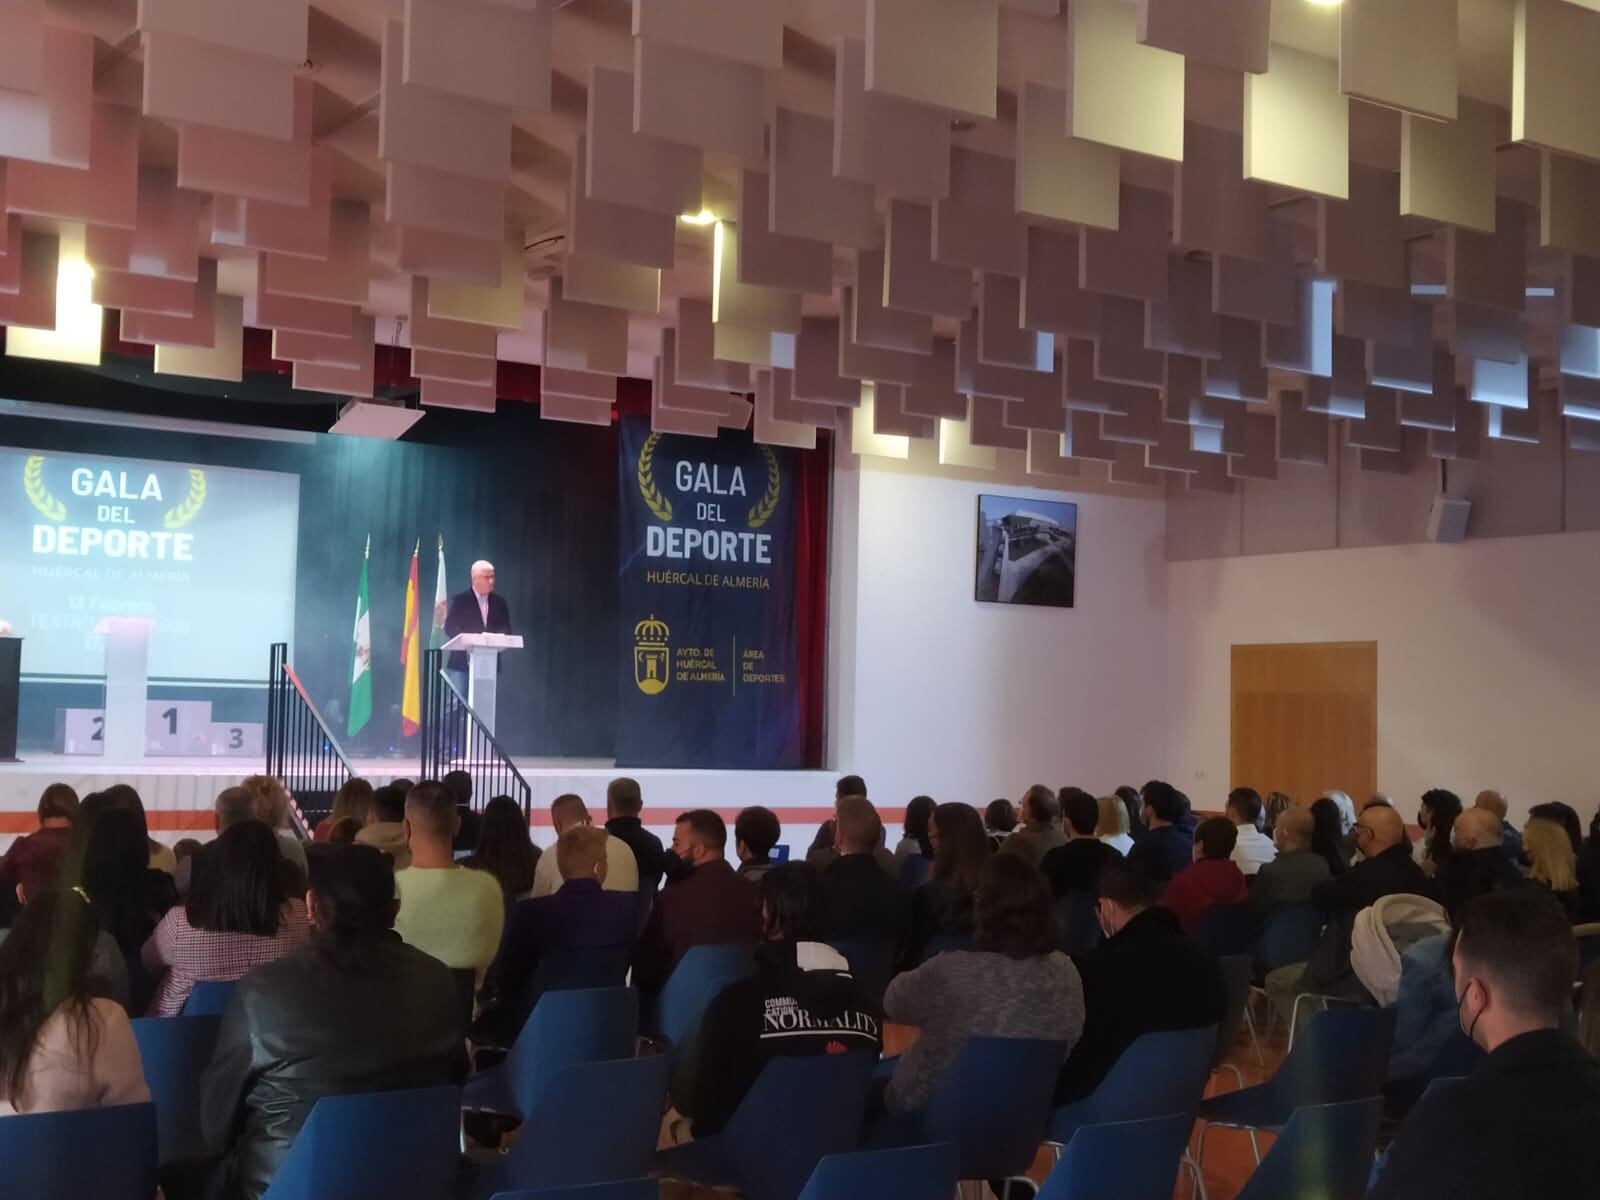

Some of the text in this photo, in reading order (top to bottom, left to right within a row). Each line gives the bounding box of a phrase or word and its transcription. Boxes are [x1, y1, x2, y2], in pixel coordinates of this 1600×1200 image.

[71, 467, 163, 502] GALA
[675, 460, 747, 497] GALA
[97, 504, 136, 524] DEL
[696, 502, 726, 523] DEL
[32, 524, 194, 561] DEPORTE
[646, 525, 772, 564] DEPORTE
[647, 569, 770, 590] HUÉRCAL DE ALMERÍA
[704, 648, 715, 657] DE
[676, 659, 717, 669] HUÉRCAL
[743, 662, 754, 671] DE
[676, 671, 725, 681] DE ALMERÍA
[743, 673, 786, 683] DEPORTES
[91, 716, 104, 741] 2
[162, 707, 178, 735] 1
[228, 727, 244, 749] 3
